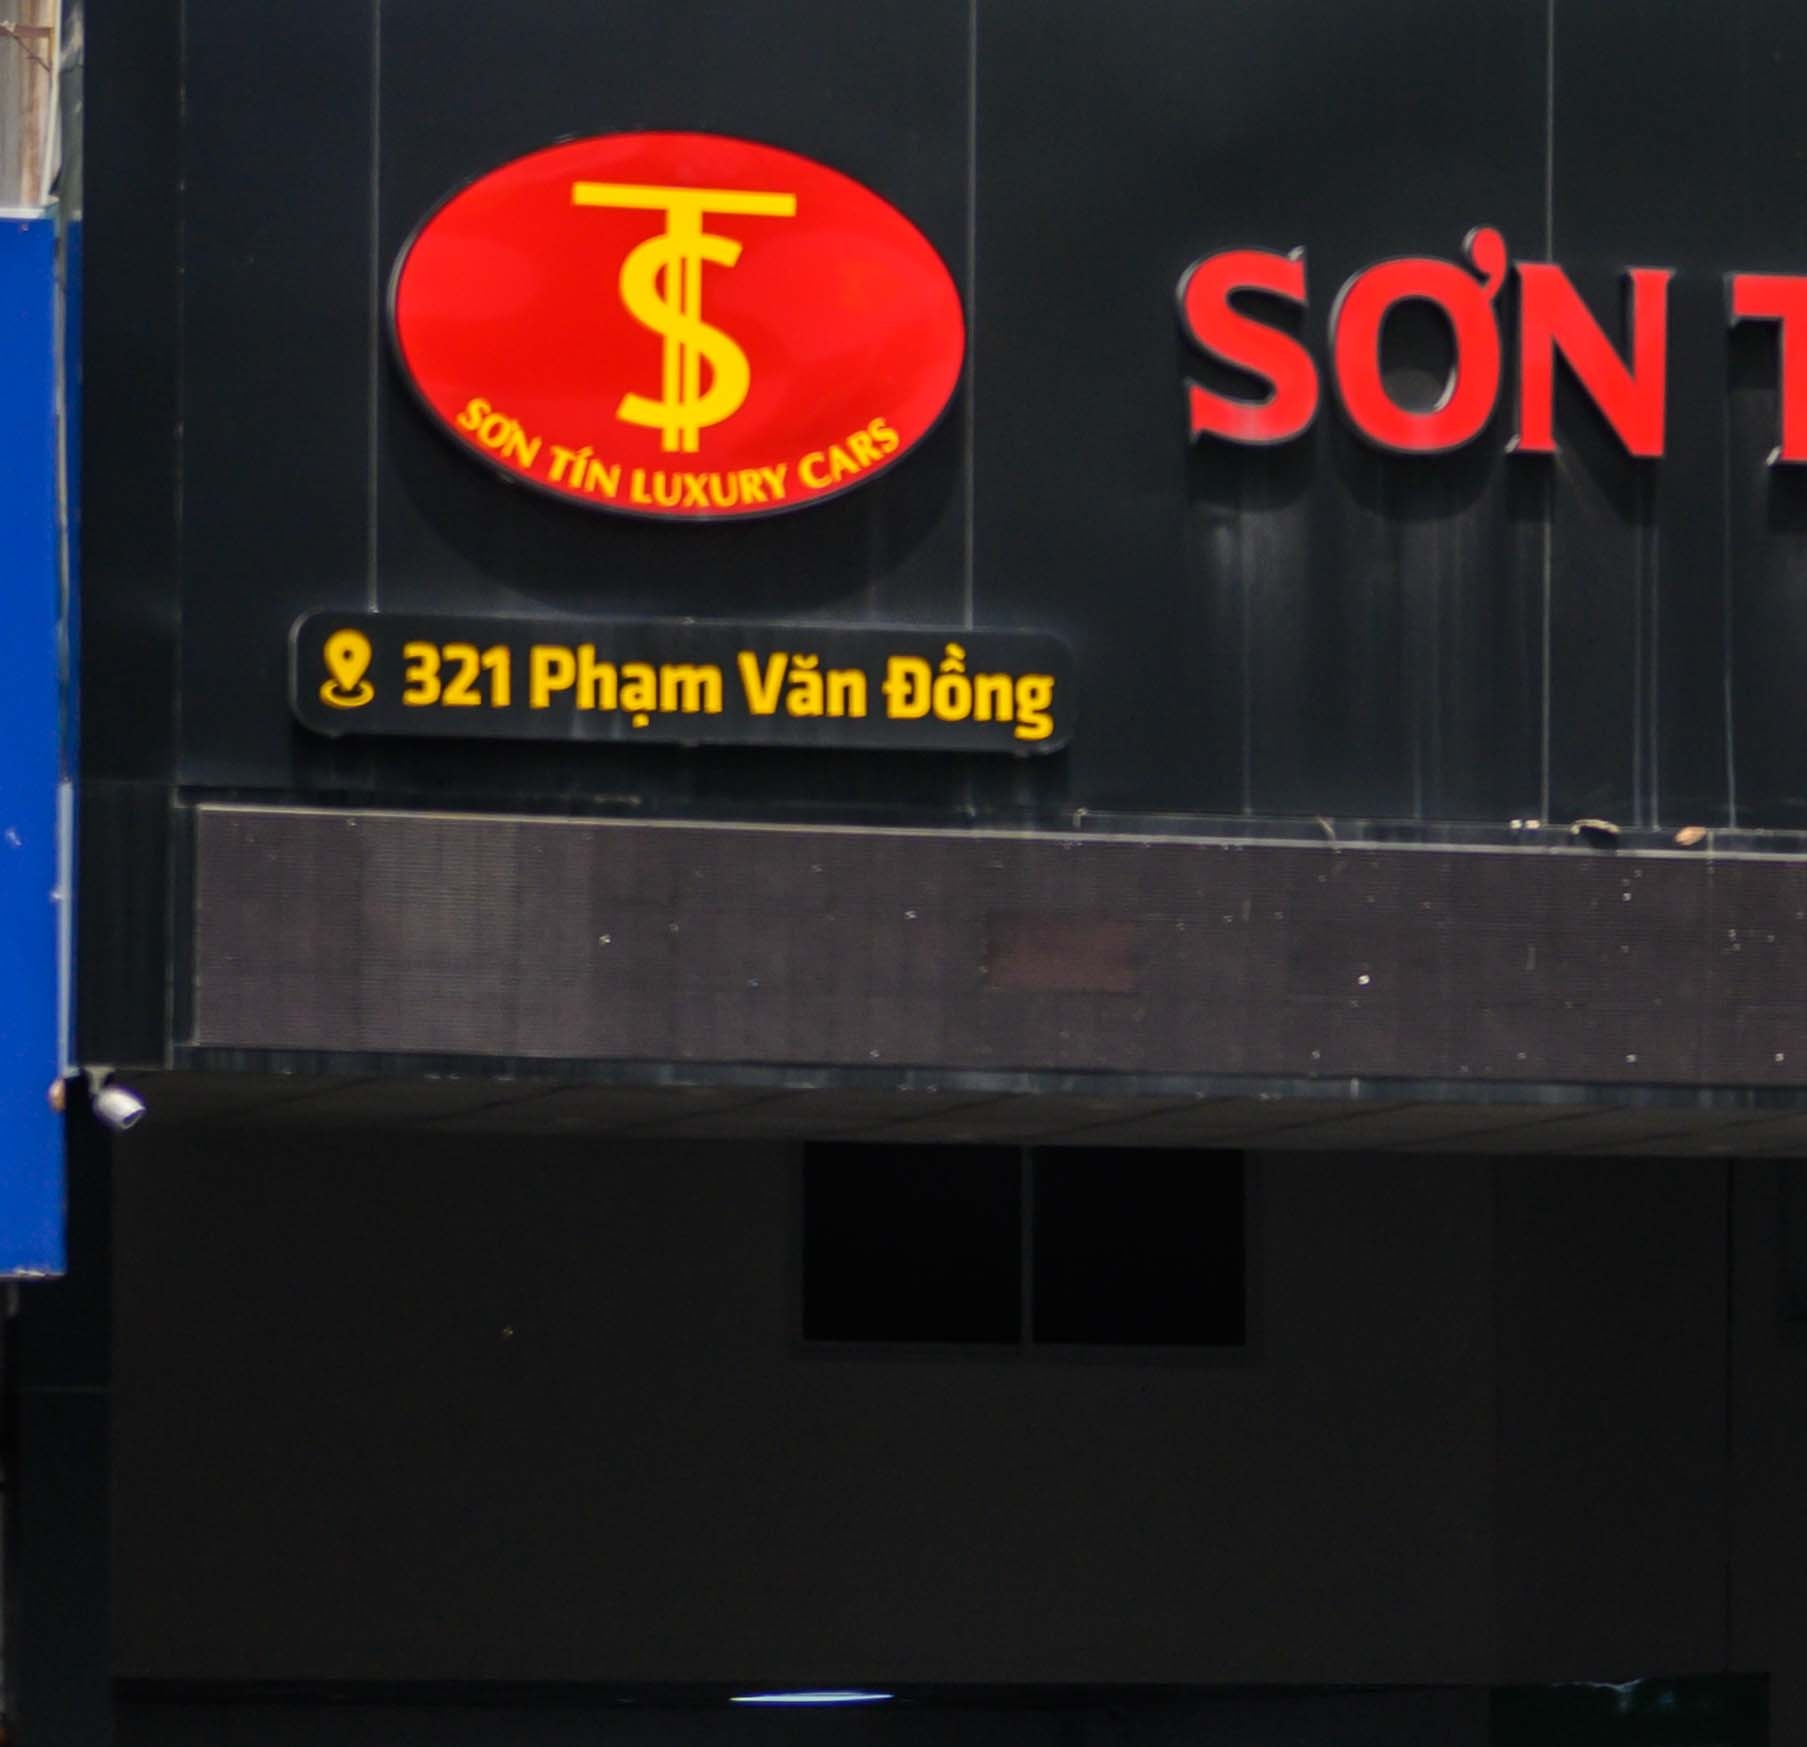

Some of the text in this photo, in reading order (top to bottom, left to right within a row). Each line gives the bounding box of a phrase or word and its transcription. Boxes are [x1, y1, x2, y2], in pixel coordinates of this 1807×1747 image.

[1178, 226, 1671, 456] SƠN
[456, 398, 900, 508] SƠN TÍN LUXURY CARS
[403, 643, 1055, 740] 321 Phạm Văn Đồng
